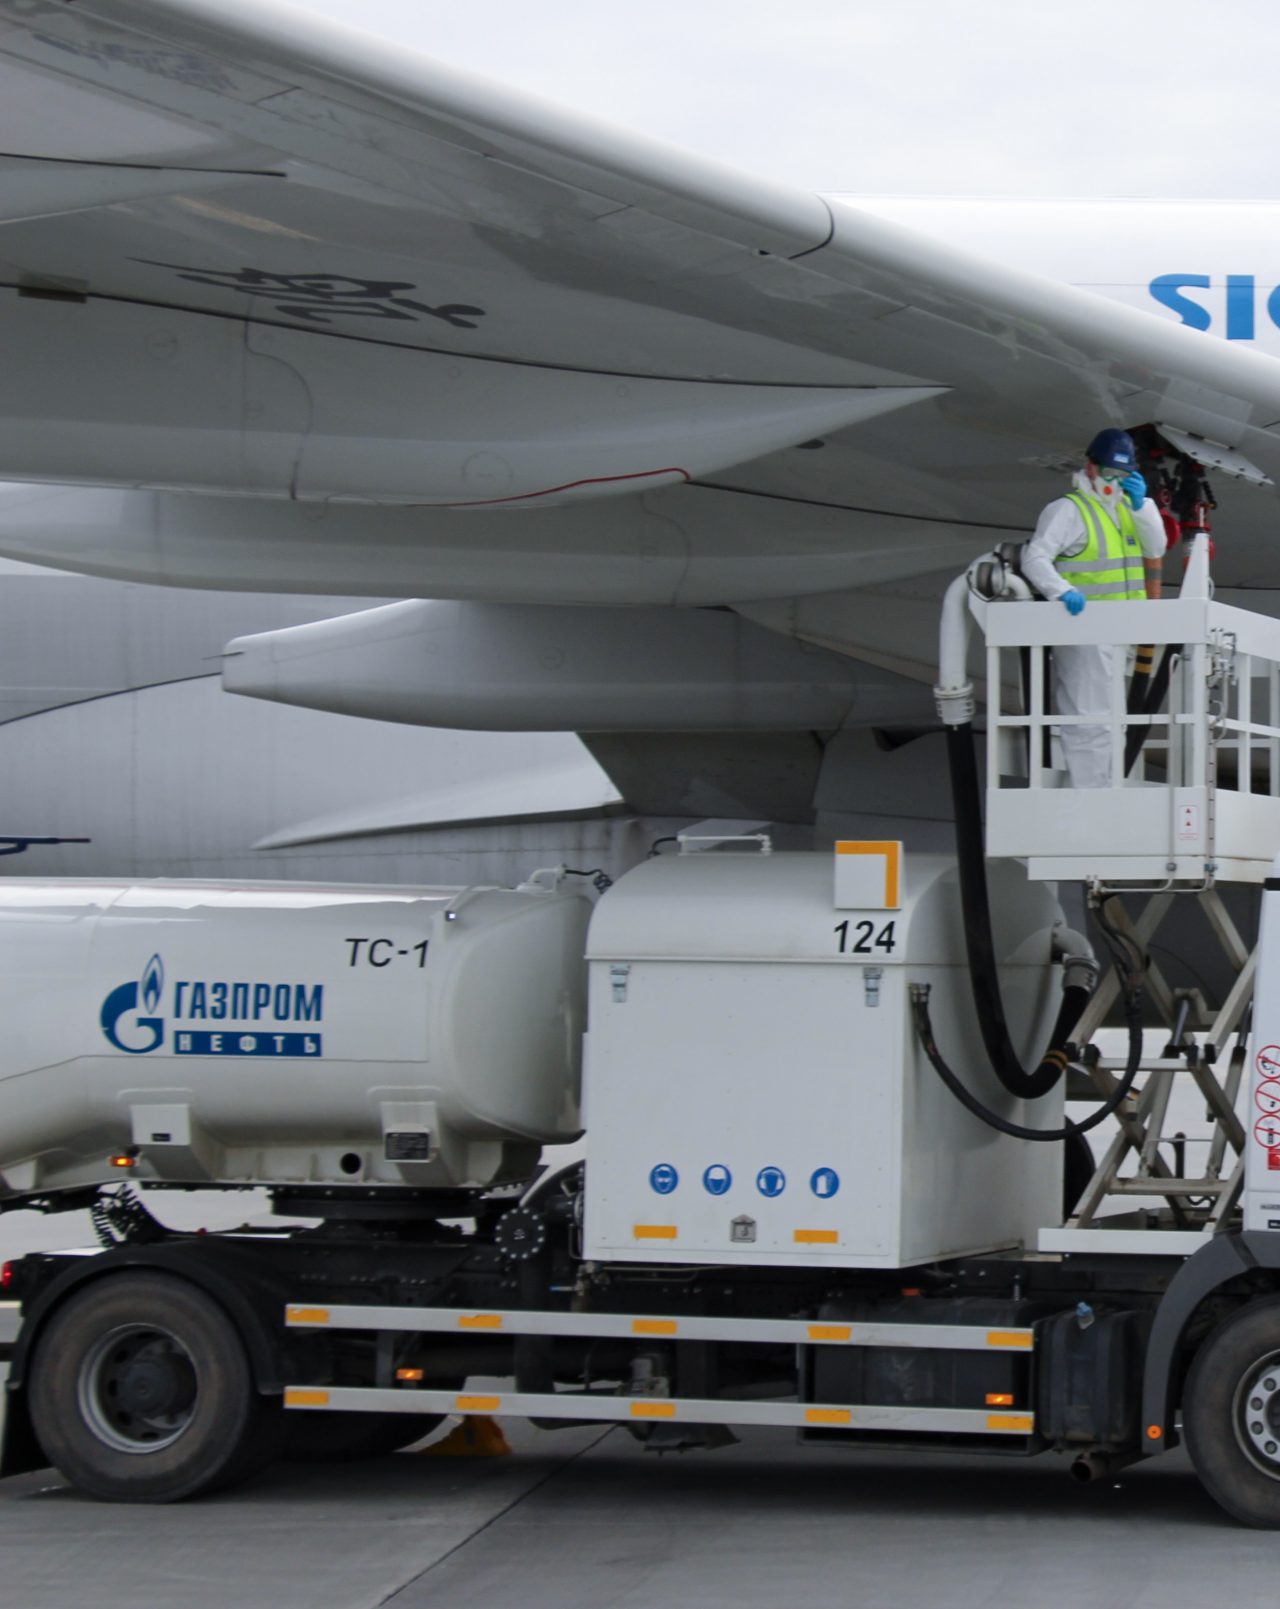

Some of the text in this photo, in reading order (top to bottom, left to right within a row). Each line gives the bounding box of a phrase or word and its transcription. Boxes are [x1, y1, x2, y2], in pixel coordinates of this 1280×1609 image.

[833, 920, 896, 953] 124
[175, 982, 324, 1021] ГАЗПРОМ
[179, 1034, 317, 1053] НЕФТЬ
